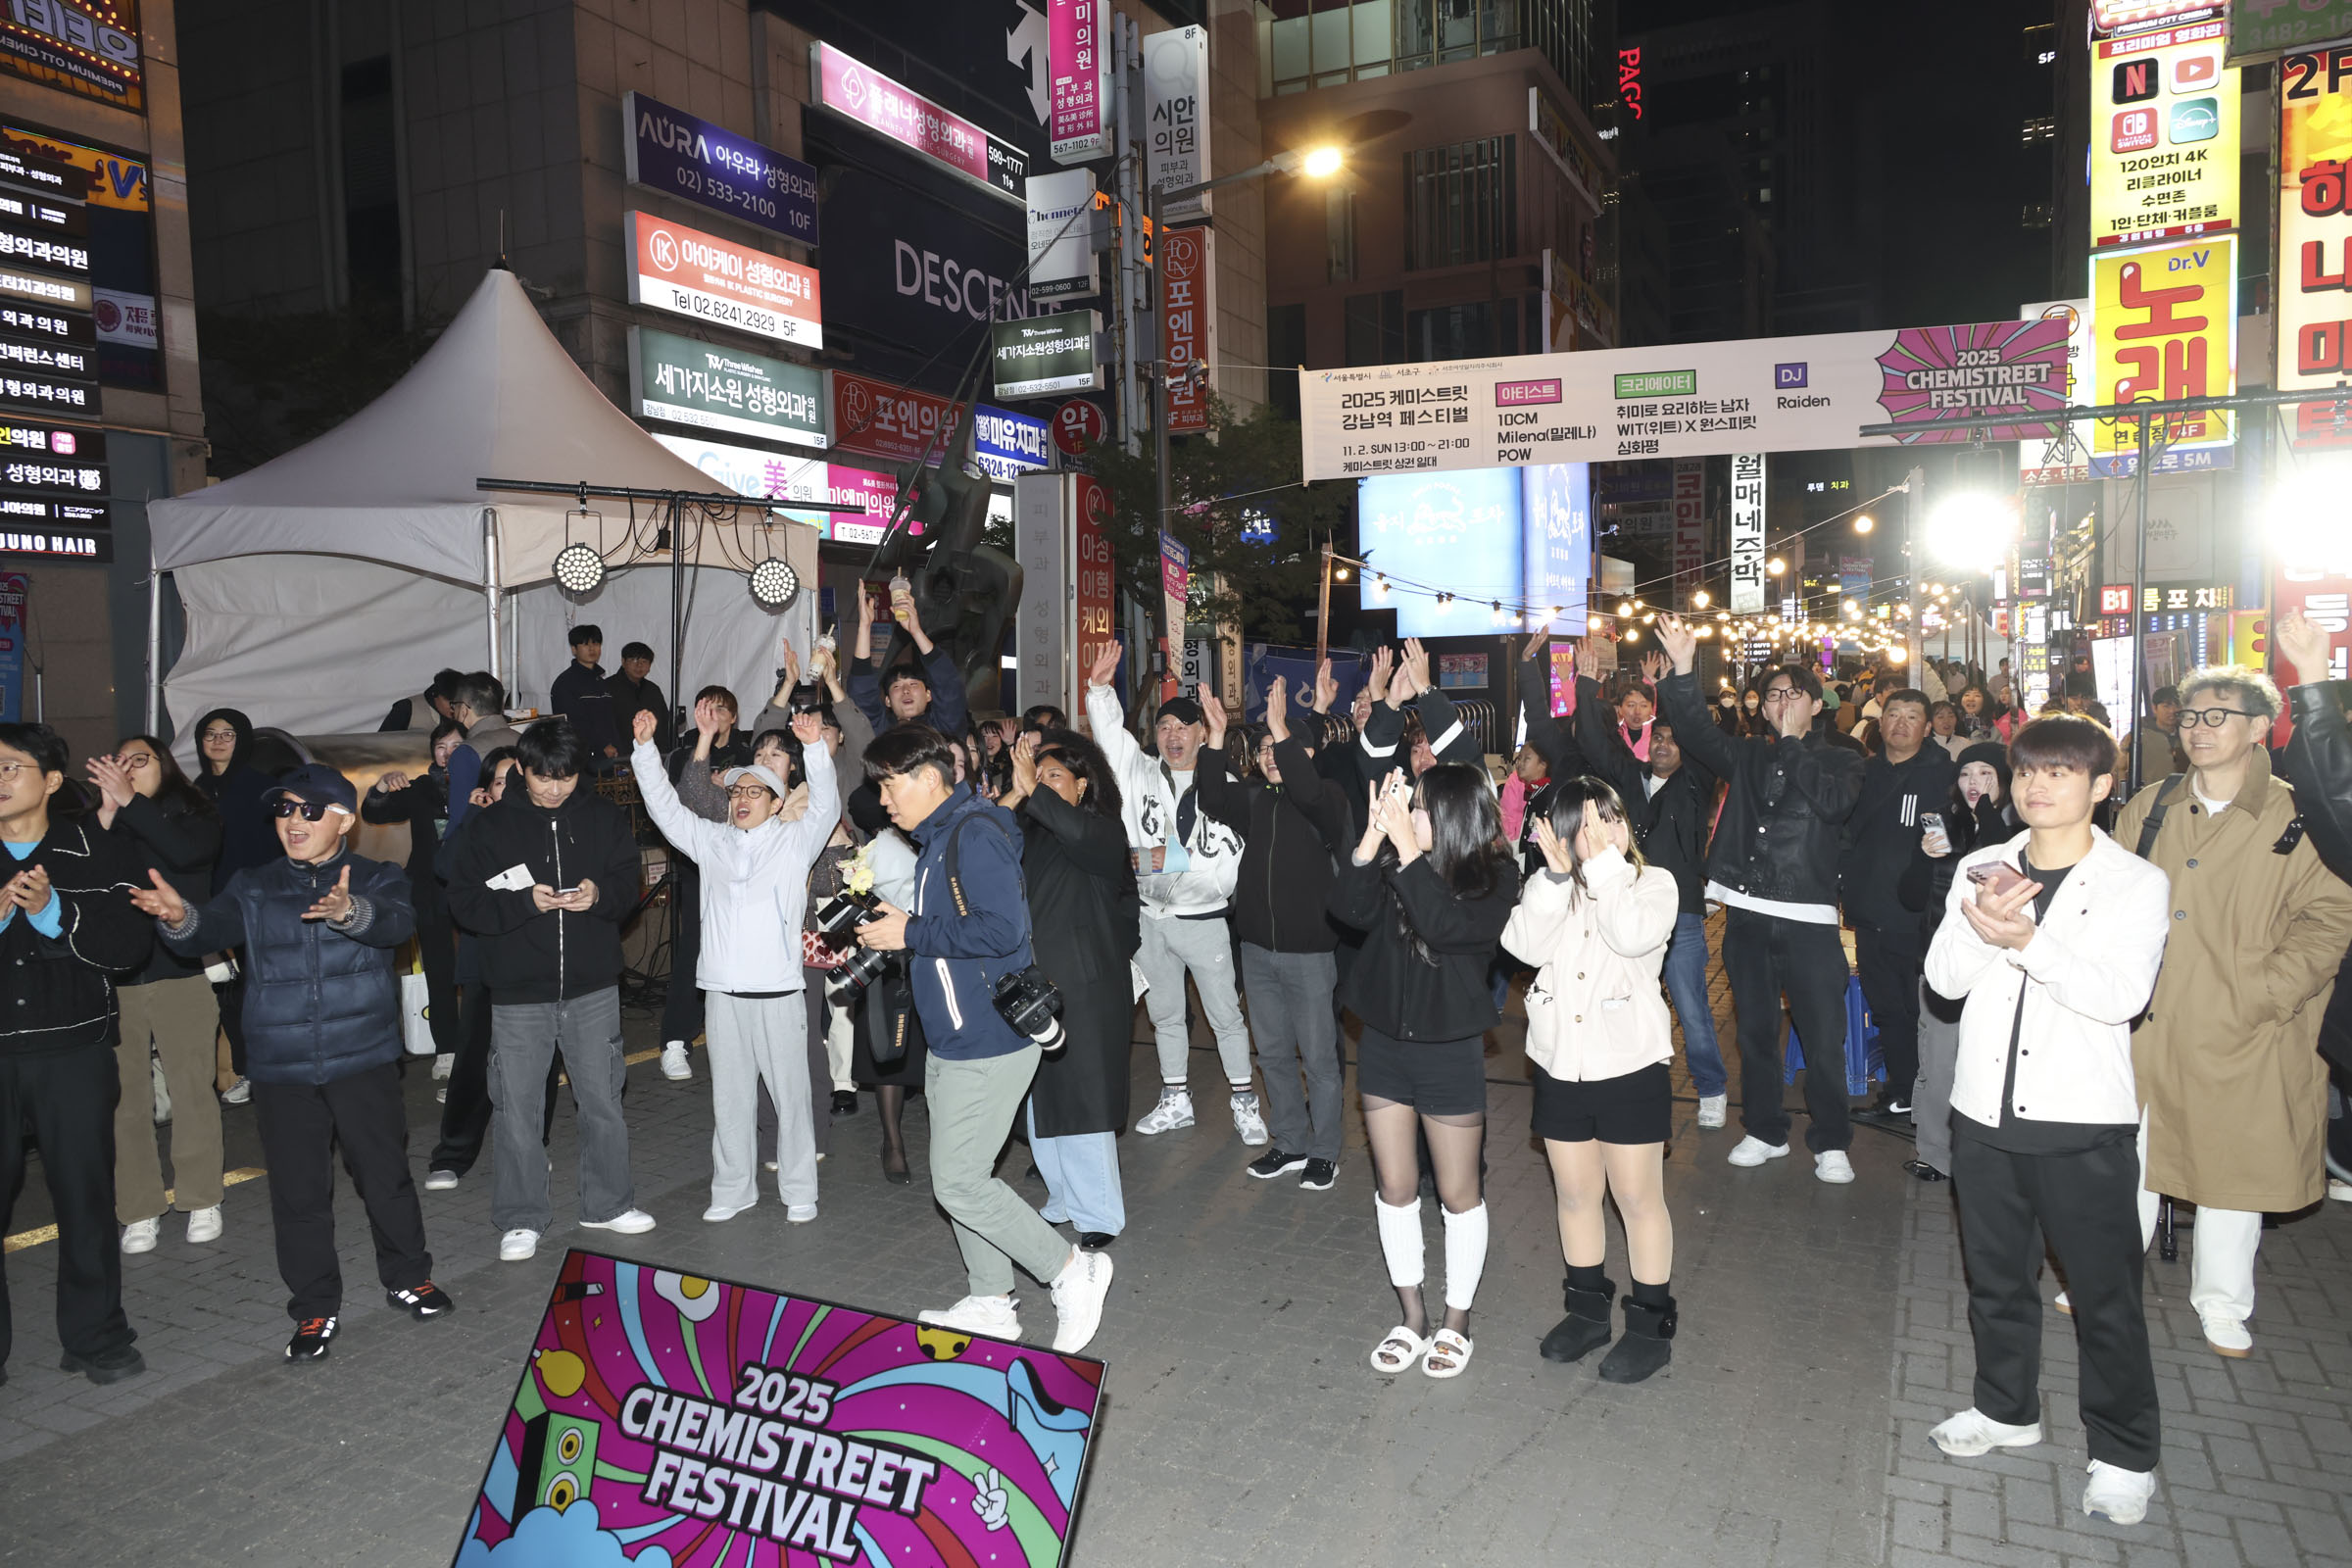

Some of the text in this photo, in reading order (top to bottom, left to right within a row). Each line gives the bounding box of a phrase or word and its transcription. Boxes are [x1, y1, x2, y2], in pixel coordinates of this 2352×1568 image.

[2158, 13, 2178, 26] OTT
[1075, 0, 1093, 71] 미의원
[1184, 27, 1198, 40] 8F
[2110, 23, 2223, 55] 프리미엄 영화관
[1055, 92, 1093, 110] 성형외과
[1152, 95, 1196, 127] 시안
[1054, 137, 1100, 154] 567-1102 9F
[1153, 126, 1195, 156] 의원
[2117, 137, 2153, 150] SWITCH
[936, 145, 965, 167] SURGERY
[988, 146, 1024, 176] 599-1777
[1160, 159, 1189, 174] 피부과
[2120, 148, 2209, 173] 120인치 4K
[30, 170, 64, 186] 성형외과
[715, 145, 760, 181] 아우라
[763, 164, 817, 204] 성형외과
[1156, 172, 1194, 189] 성형외과
[2126, 168, 2203, 191] 리클라이너
[676, 166, 811, 230] 02) 533-2100 10F
[2141, 188, 2187, 208] 수면존
[682, 239, 743, 280] 아이케이
[746, 259, 802, 297] 성형외과
[2167, 249, 2210, 272] Dr.V
[894, 238, 1063, 321] DESCEN
[1031, 281, 1072, 295] 02-599-0600
[672, 289, 797, 337] Tel 02.6241.2929 5F
[2114, 261, 2209, 423] 노래
[1956, 349, 2001, 367] 2025
[1078, 376, 1091, 387] 15F
[1333, 371, 1372, 383] 서울특별시
[1396, 368, 1421, 377] 서초구
[1620, 373, 1692, 393] 크리에이터
[1780, 368, 1803, 383] DJ
[1906, 363, 2053, 390] CHEMISTREET
[0, 378, 86, 406] 형외과의원
[655, 362, 816, 424] 세가지소원 성형외과 의원
[1341, 384, 1469, 410] 2025 케미스트릿
[1500, 383, 1557, 401] 아티스트
[1777, 394, 1832, 410] Raiden
[1930, 385, 2029, 410] FESTIVAL
[1342, 405, 1470, 431] 강남역 페스티벌
[1616, 397, 1750, 418] 취미로 요리하는 남자
[1497, 412, 1539, 427] 10CM
[1616, 415, 1757, 437] WIT(위트) X 원스피릿
[2177, 424, 2199, 437] 4F
[812, 435, 825, 446] 15F
[989, 416, 1040, 458] 미유치과
[1497, 425, 1597, 444] Milena(밀레나)
[1370, 441, 1393, 455] SUN
[1394, 440, 1426, 453] 13:00
[1437, 437, 1470, 451] 21:00
[1497, 447, 1532, 462] POW
[1617, 438, 1660, 456] 심화평
[1343, 455, 1439, 473] 케미스트릿 상권 일대
[2183, 451, 2213, 466] 5M
[6, 463, 77, 487] 성형외과
[1830, 479, 1850, 490] 치과
[1733, 453, 1763, 587] 월매네주막
[52, 535, 97, 556] HAIR
[2102, 589, 2130, 611] B1
[950, 876, 968, 916] SAMSUNG
[895, 1013, 906, 1048] SAMSUNG
[735, 1366, 836, 1425] 2025
[618, 1387, 936, 1515] CHEMISTREET
[644, 1452, 859, 1560] FESTIVAL
